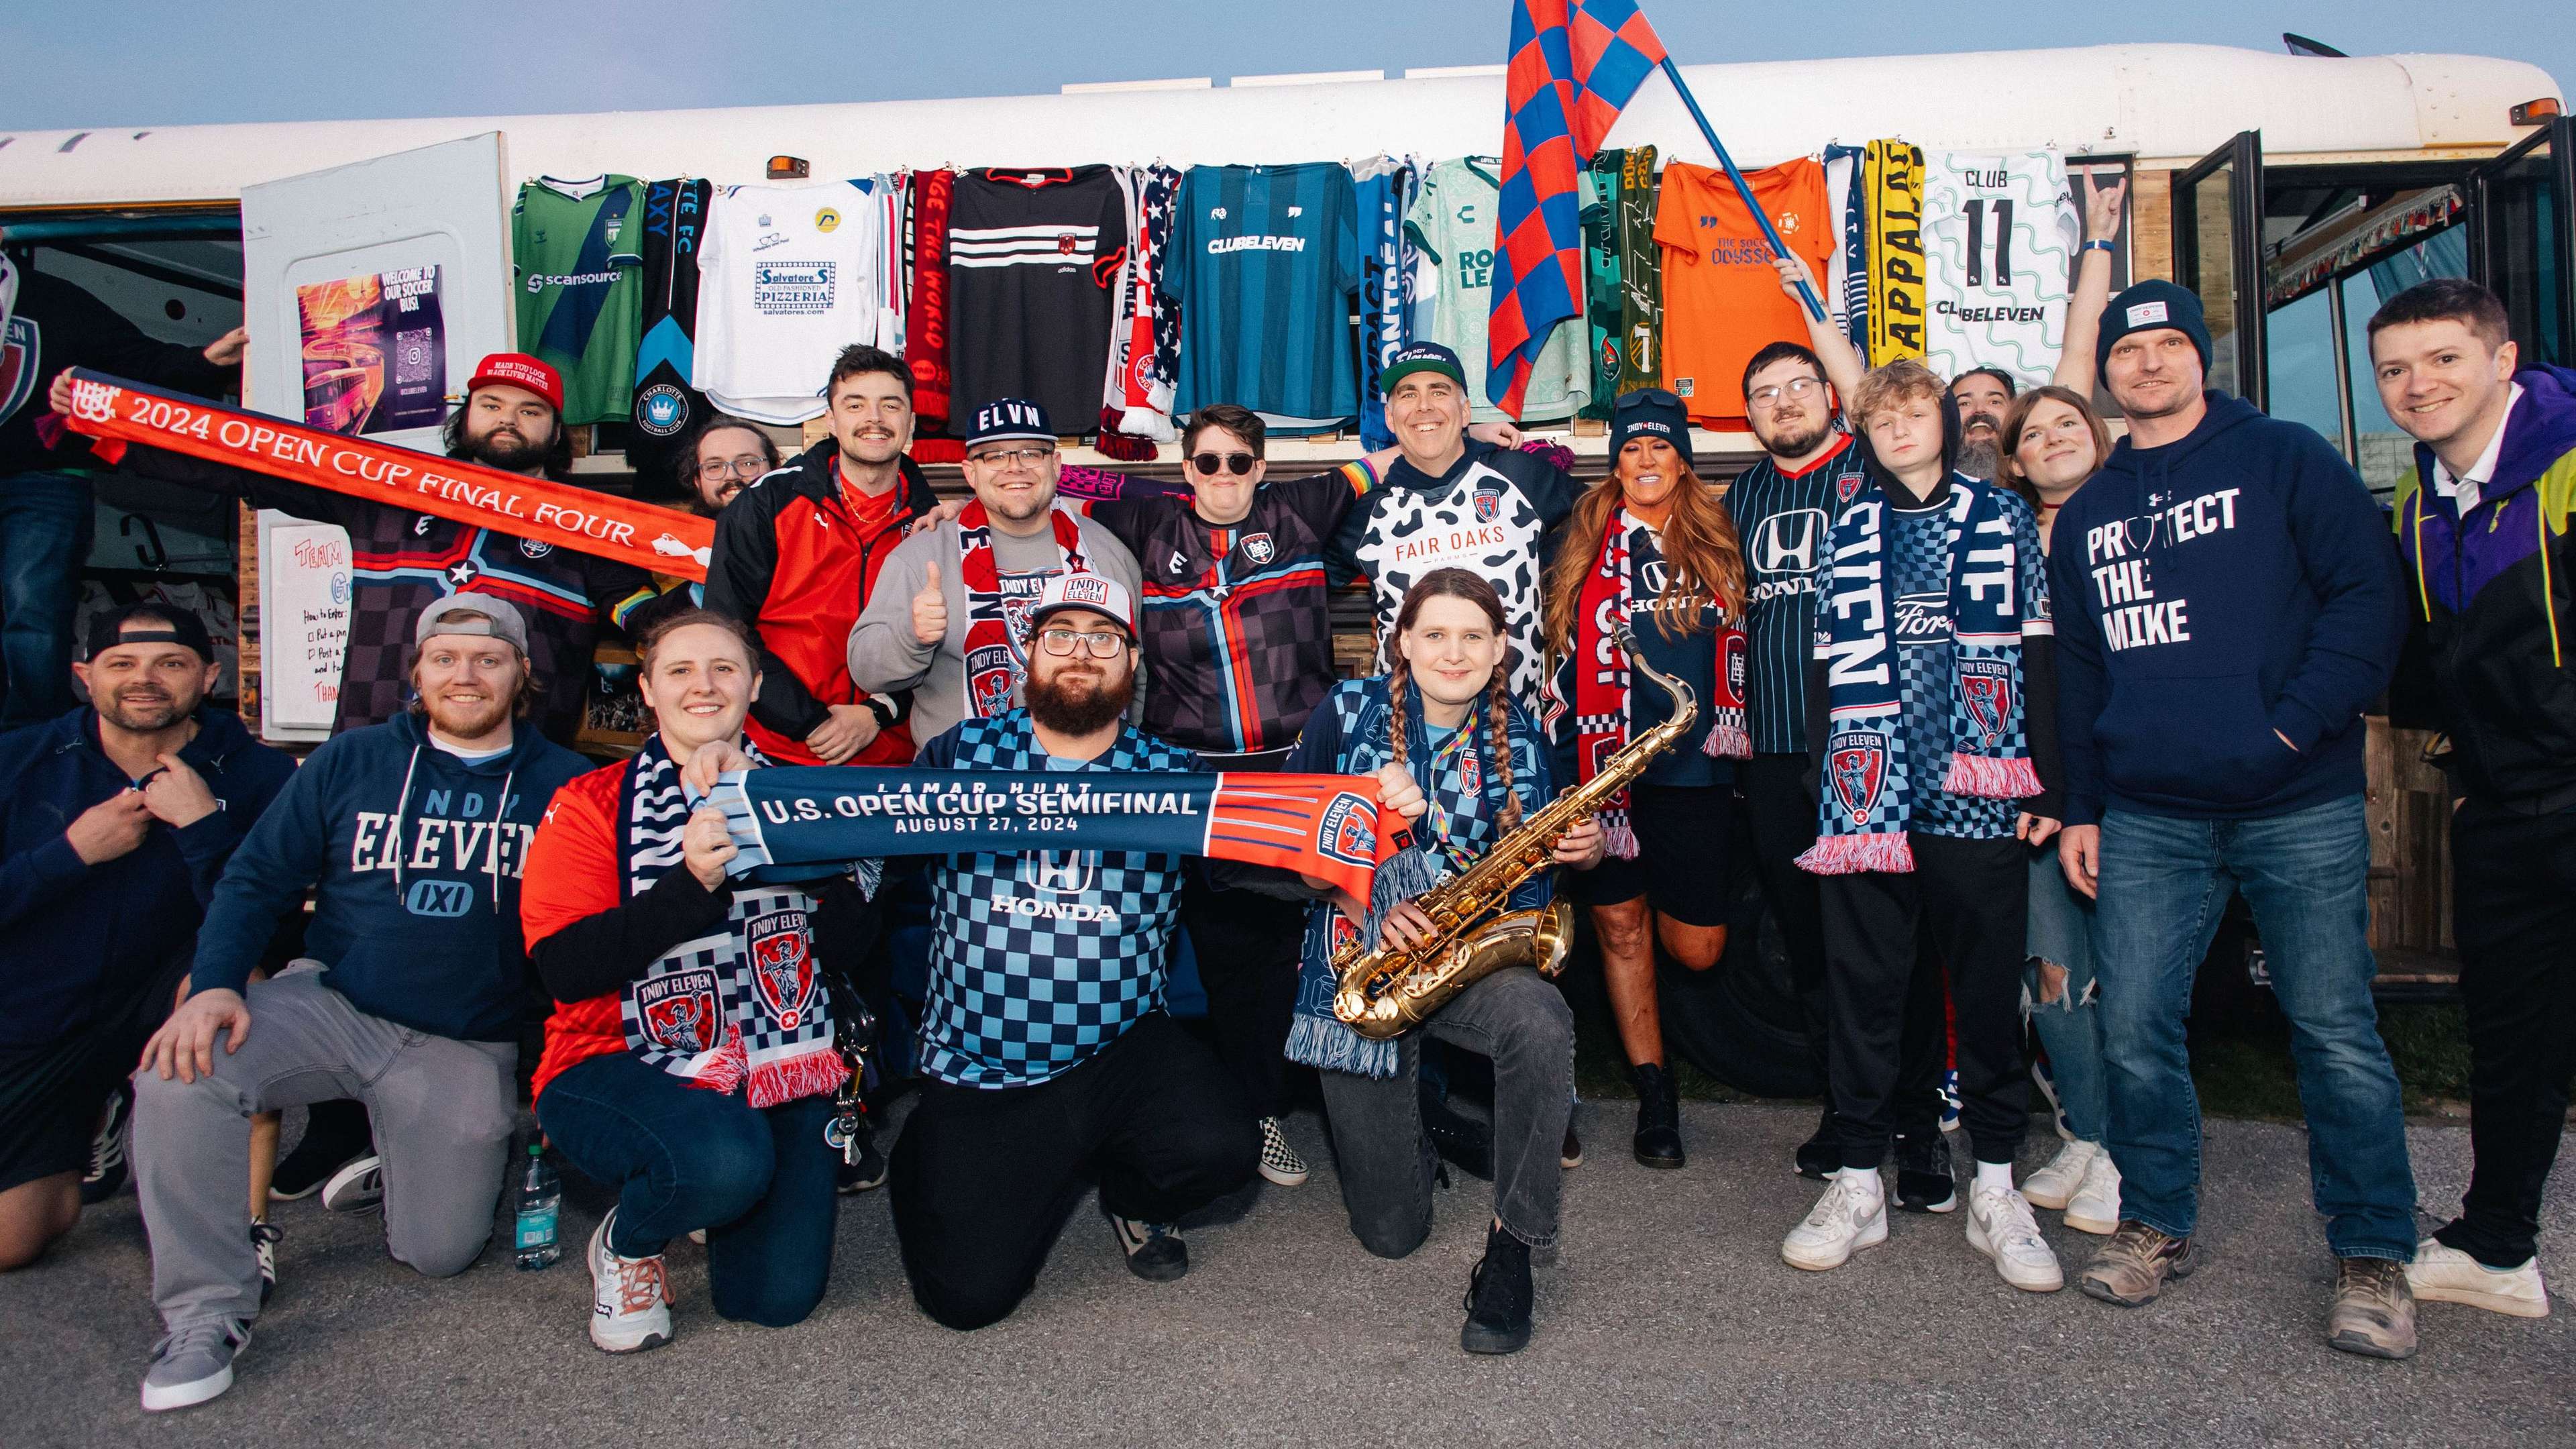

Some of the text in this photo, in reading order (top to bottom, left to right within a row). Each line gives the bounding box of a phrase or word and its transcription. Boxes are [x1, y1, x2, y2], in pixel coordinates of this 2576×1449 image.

[1966, 170, 2007, 188] CLUB
[678, 225, 695, 254] FC
[924, 221, 943, 262] THE
[1208, 235, 1306, 254] CLUBELEVEN
[1717, 237, 1735, 248] THE
[1962, 199, 2013, 287] 11
[382, 266, 436, 287] WELCOME TO
[545, 271, 623, 286] scansource
[1460, 268, 1493, 289] LE
[384, 279, 433, 301] OUR SOCCER
[761, 292, 827, 302] PIZZERIA
[399, 295, 420, 313] BUS!
[923, 270, 945, 349] WORLD
[1936, 300, 2045, 322] CLBELEVEN
[494, 362, 547, 380] MADE YOU LOOK
[506, 369, 527, 380] LIVES
[643, 386, 683, 401] CHARLOTTE
[642, 419, 682, 434] FOOTBALL CLUB
[977, 402, 1040, 431] ELVN
[1627, 421, 1671, 434] INDY ELEVEN
[130, 397, 636, 549] 2024 OPEN CUP FINAL FOUR
[1395, 526, 1505, 561] FAIR OAKS
[294, 539, 343, 569] TEAM
[1000, 578, 1029, 594] INDY
[1069, 579, 1104, 594] INDY
[2091, 558, 2155, 608] THE
[1066, 591, 1103, 602] ELEVEN
[304, 610, 319, 625] How
[320, 608, 327, 619] to
[1895, 599, 1953, 635] For
[2102, 598, 2191, 652] MIKE
[317, 628, 328, 641] Put
[318, 647, 333, 660] Post
[970, 651, 992, 672] INDY
[314, 661, 328, 674] and
[1959, 659, 2008, 676] INDY ELEVEN
[1831, 734, 1882, 747] INDY ELEVEN
[877, 782, 1092, 794] LAMAR HUNT
[411, 786, 520, 818] NDY
[760, 792, 1199, 824] U.S. OPEN CUP SEMIFINAL
[894, 816, 1079, 834] AUGUST 27, 2024
[1321, 797, 1354, 852] INDY ELEVEN
[989, 895, 1120, 922] HONDA
[751, 912, 806, 939] INDY ELEV
[641, 973, 712, 1004] INDY ELEVEN
